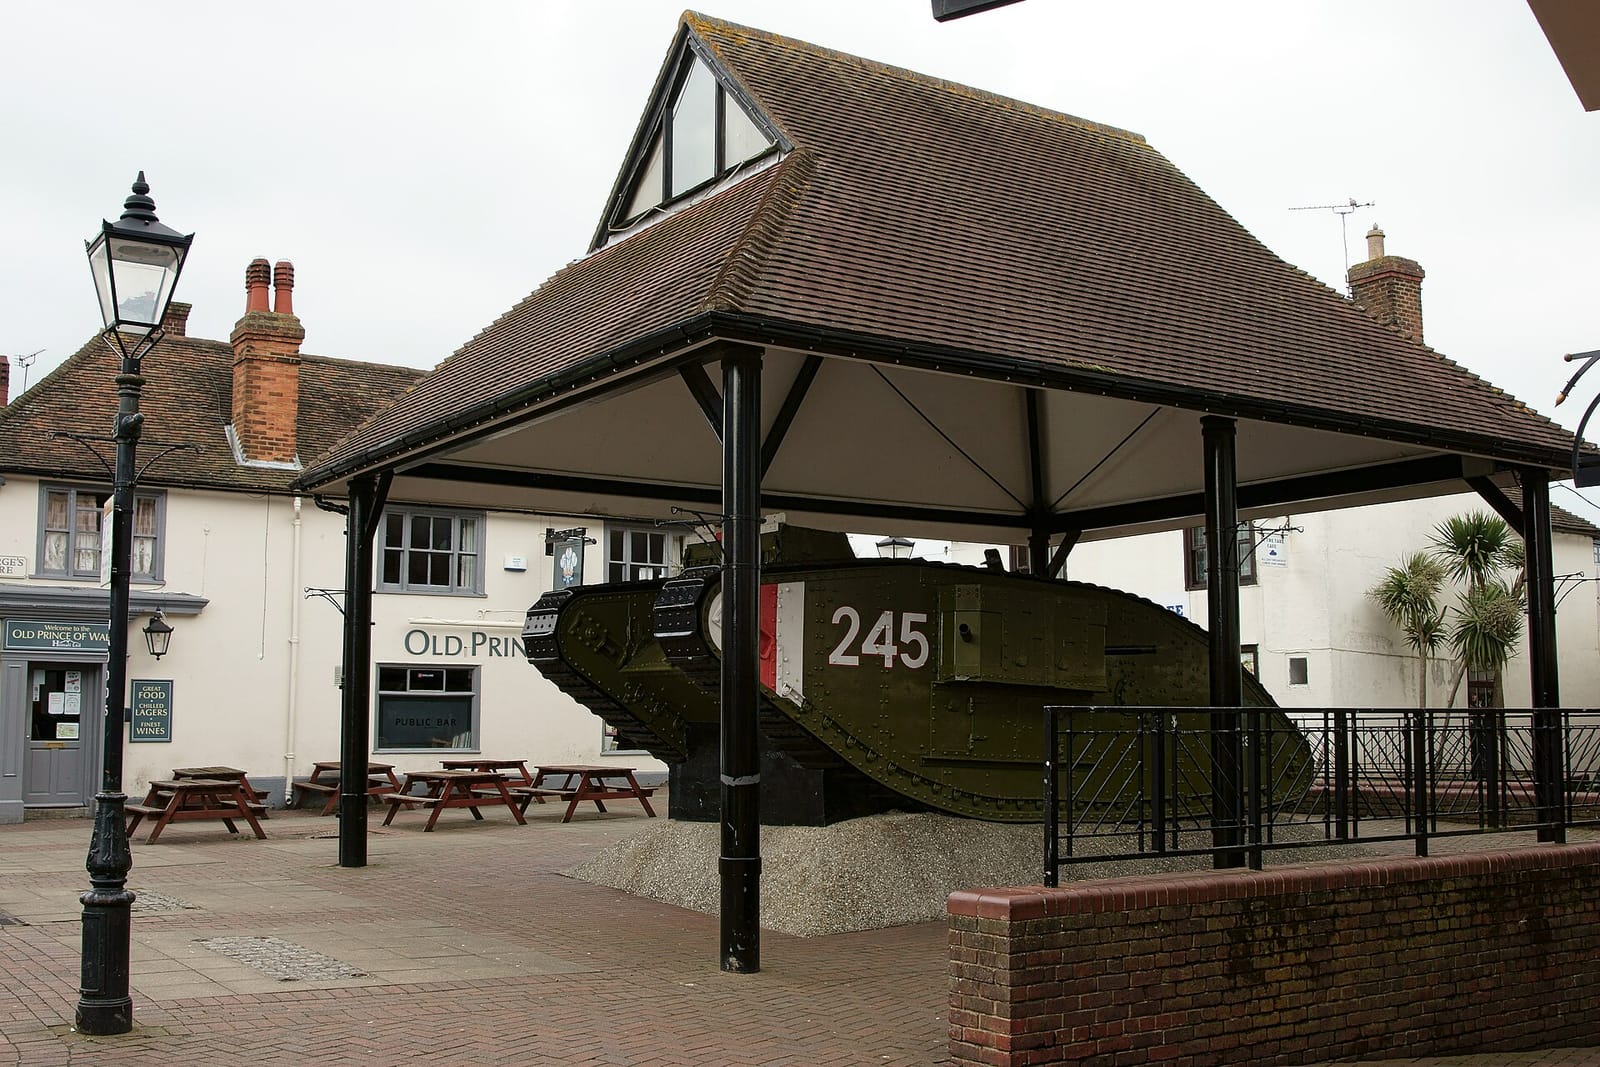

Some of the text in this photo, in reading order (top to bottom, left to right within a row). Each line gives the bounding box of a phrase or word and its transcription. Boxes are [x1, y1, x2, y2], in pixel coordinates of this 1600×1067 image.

[44, 624, 73, 632] Welcome
[12, 629, 35, 639] OLD
[37, 630, 71, 640] PRINCE
[73, 632, 87, 641] OF
[828, 605, 930, 669] 245
[404, 629, 463, 656] OLD
[138, 691, 166, 699] FOOD
[135, 708, 168, 717] LAGERS
[395, 718, 457, 727] PUBLIC BAR
[136, 727, 166, 735] WINES
